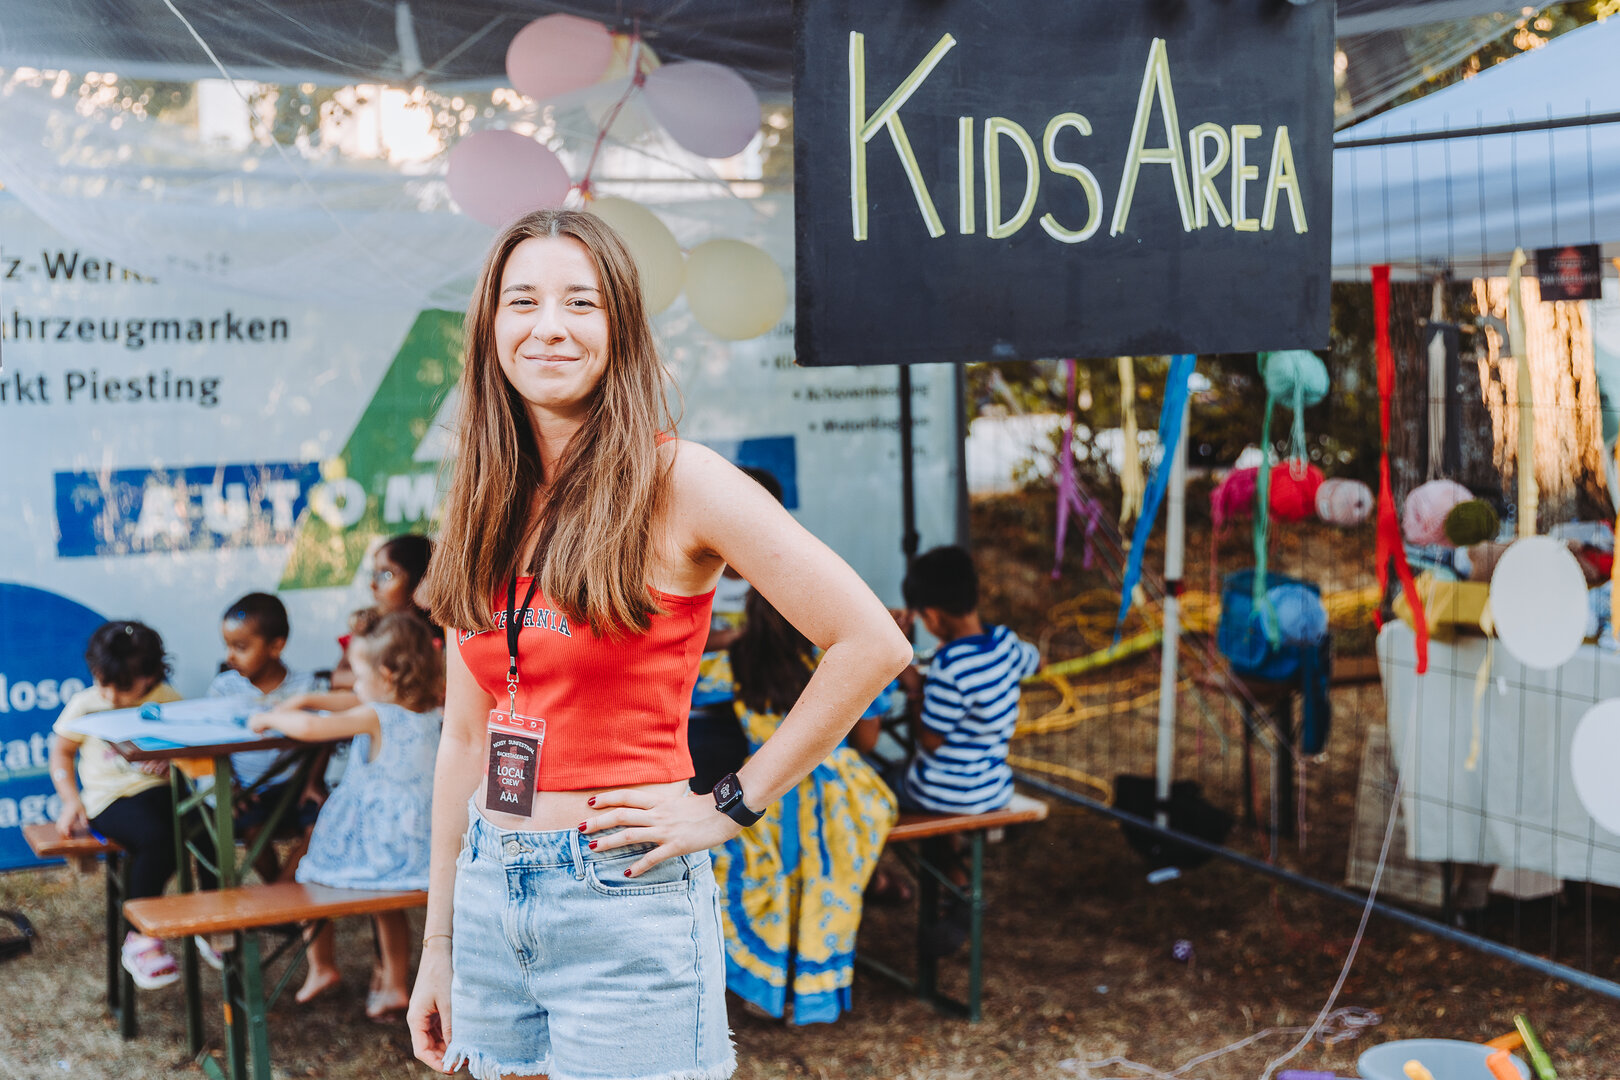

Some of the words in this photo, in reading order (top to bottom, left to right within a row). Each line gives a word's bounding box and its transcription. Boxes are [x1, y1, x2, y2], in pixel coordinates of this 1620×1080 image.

[66, 369, 220, 408] Piesting
[497, 765, 526, 780] LOCAL
[501, 777, 520, 787] CREW
[500, 790, 519, 804] AAA
